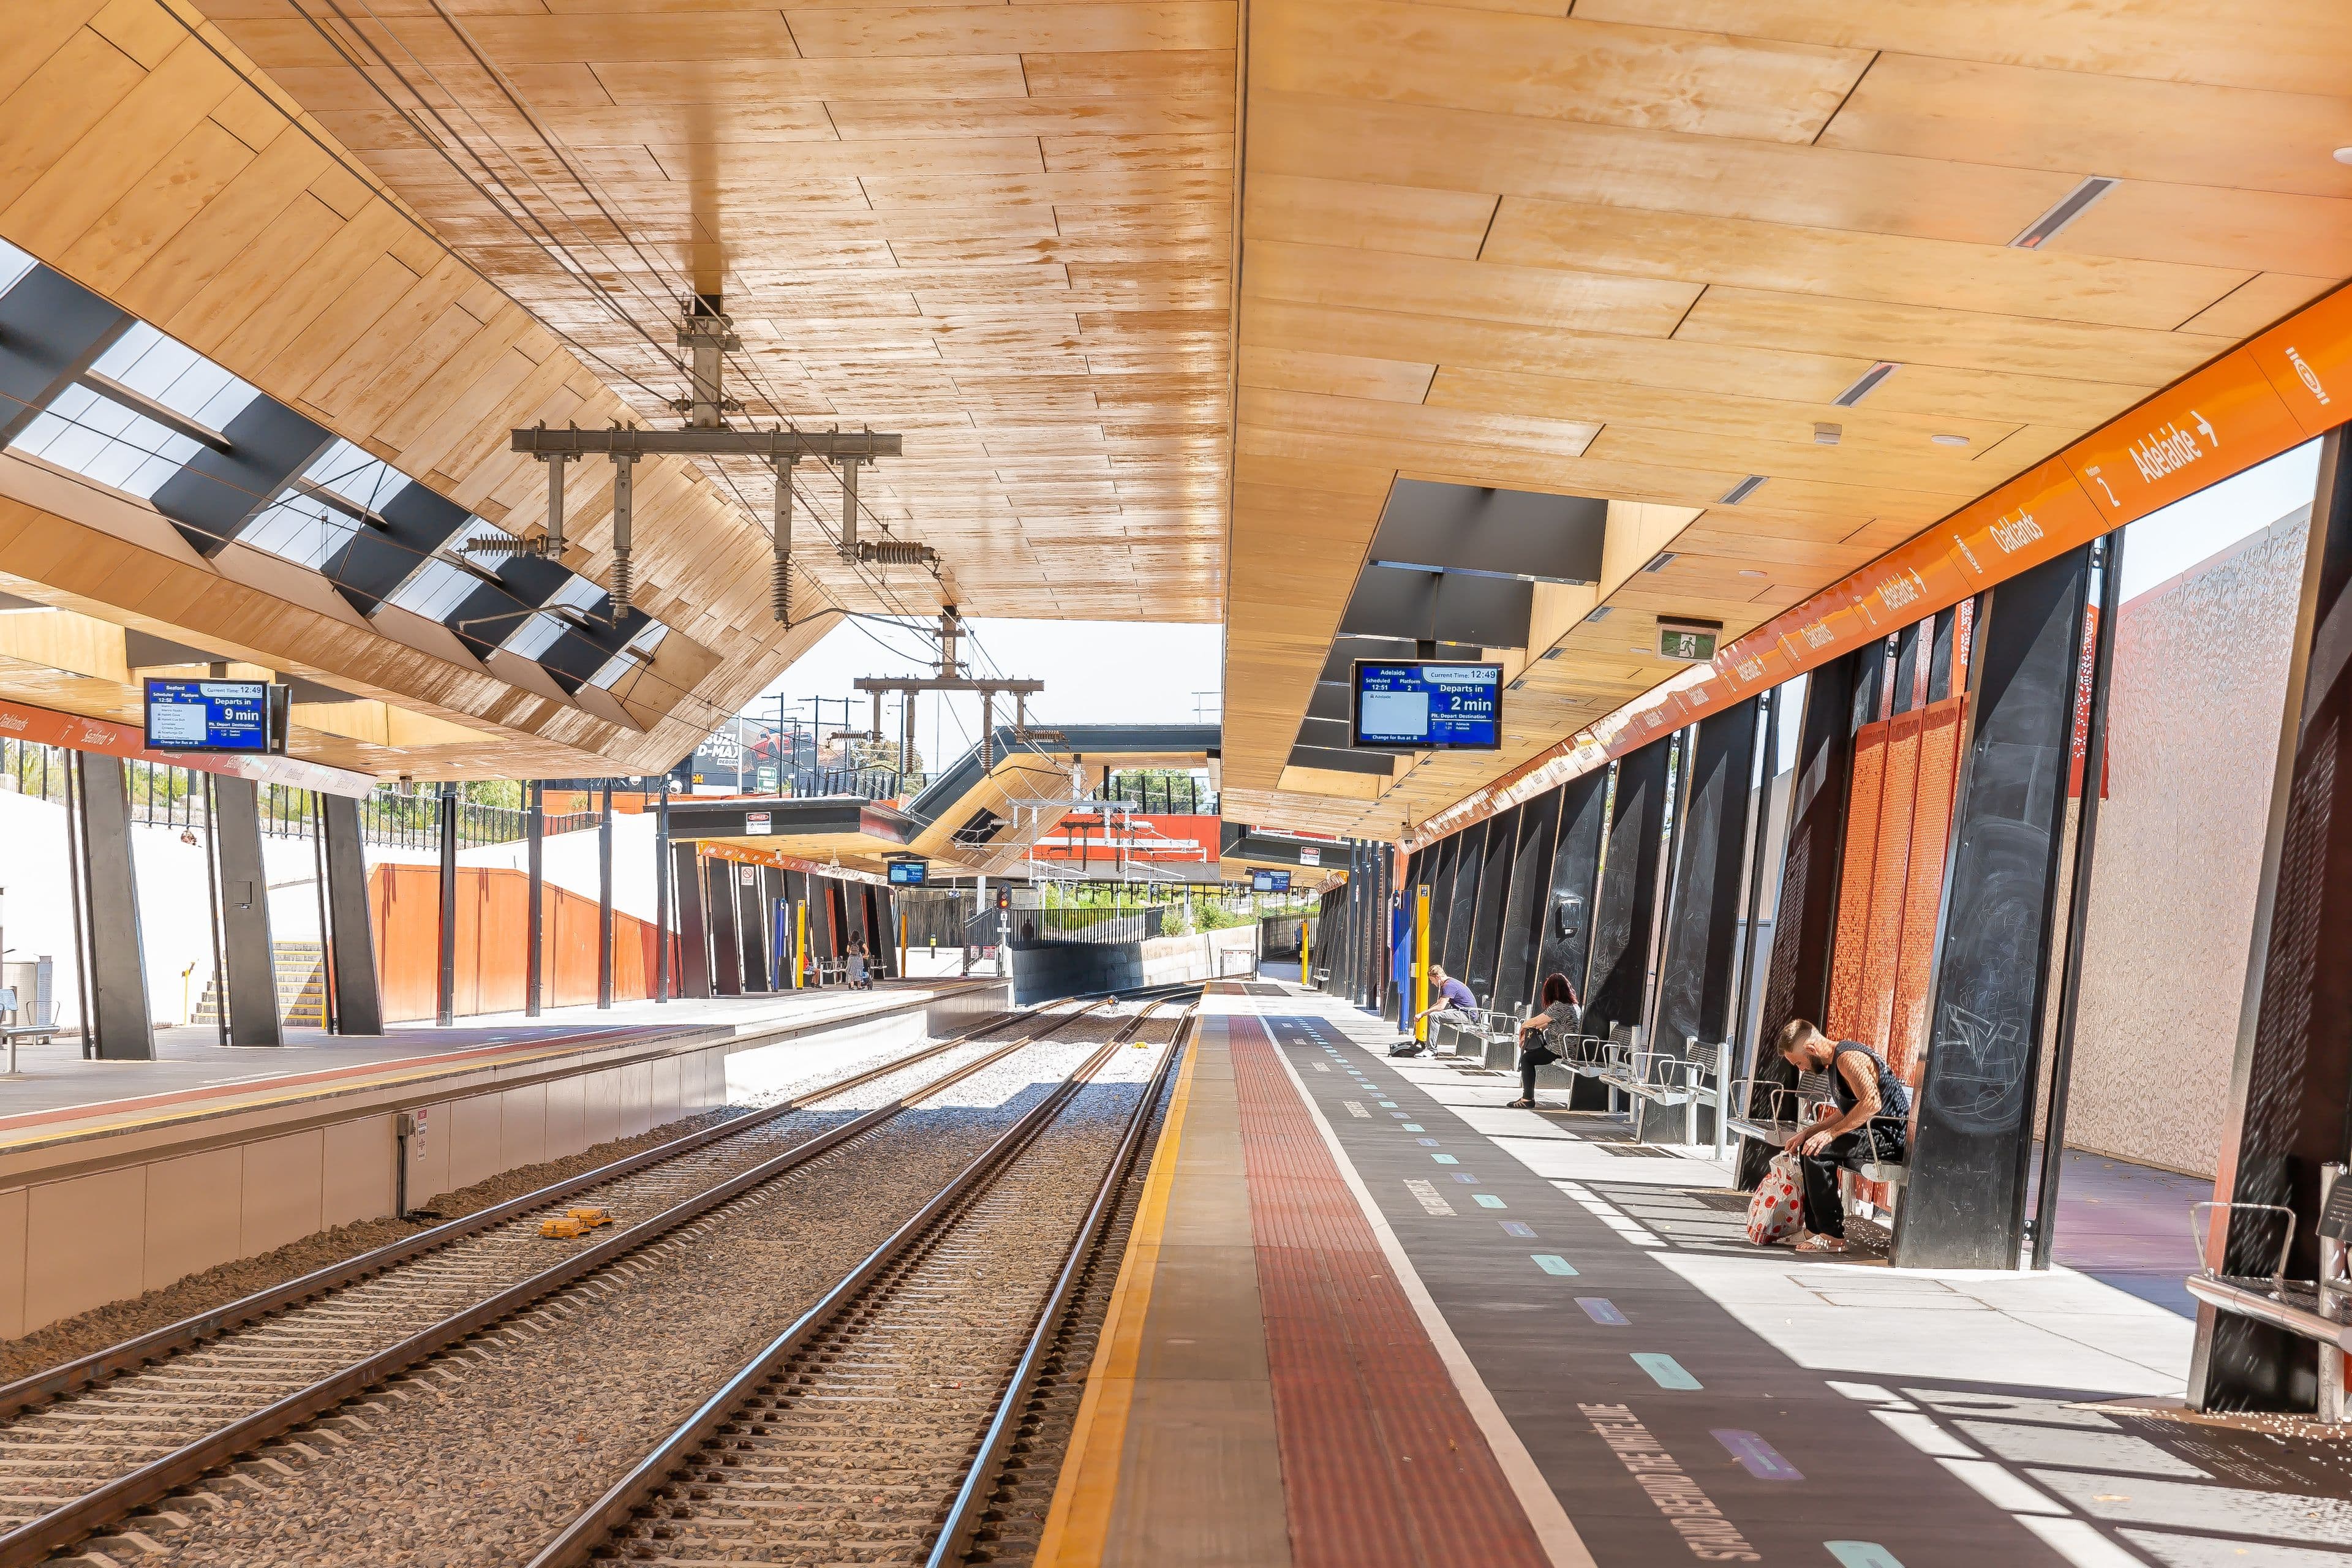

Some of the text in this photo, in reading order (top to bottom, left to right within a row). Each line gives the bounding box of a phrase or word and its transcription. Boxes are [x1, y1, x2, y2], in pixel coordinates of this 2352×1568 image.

[2096, 422, 2203, 507] 2 Adelaide
[1989, 507, 2044, 554] Oaklands
[1860, 571, 1920, 625] 2 Adelaide
[1800, 616, 1835, 649] Oaklands
[1471, 670, 1496, 679] 12:49
[1732, 654, 1762, 684] Adelaide
[1440, 684, 1473, 693] Departs
[1450, 696, 1492, 711] 2 min
[0, 713, 29, 731] Oaklands
[224, 707, 259, 721] 9 min
[80, 729, 111, 745] Seaford
